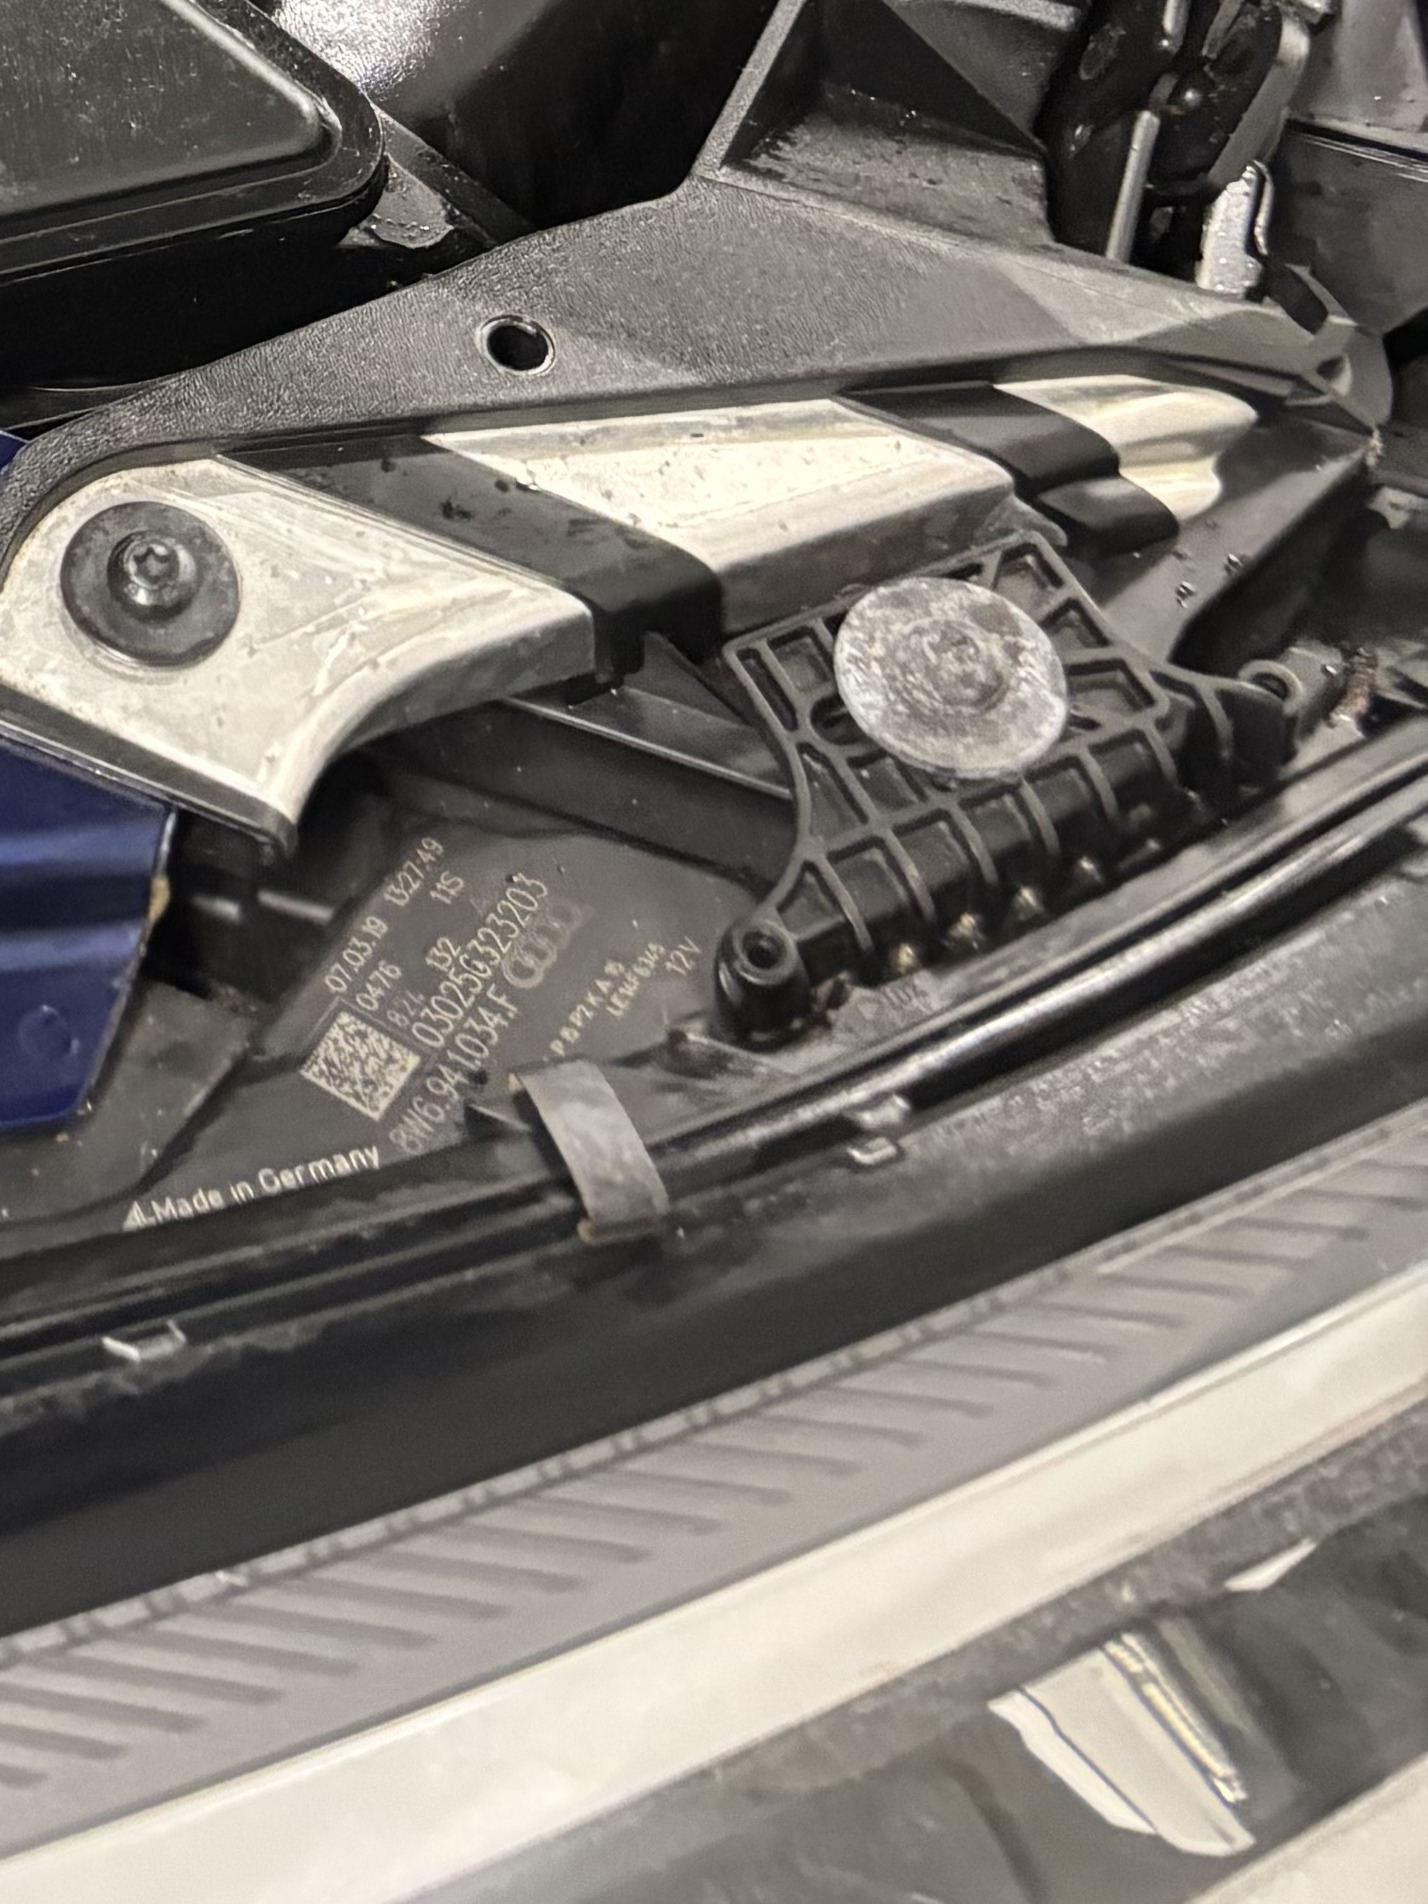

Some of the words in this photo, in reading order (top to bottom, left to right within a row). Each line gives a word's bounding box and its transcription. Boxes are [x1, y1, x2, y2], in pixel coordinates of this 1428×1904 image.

[324, 916, 390, 994] 07.03.19
[425, 937, 463, 972] 132
[663, 939, 702, 977] 12V
[356, 961, 402, 1011] 0476
[152, 1186, 225, 1225] Made
[229, 1178, 254, 1204] in
[258, 1142, 382, 1196] Germany
